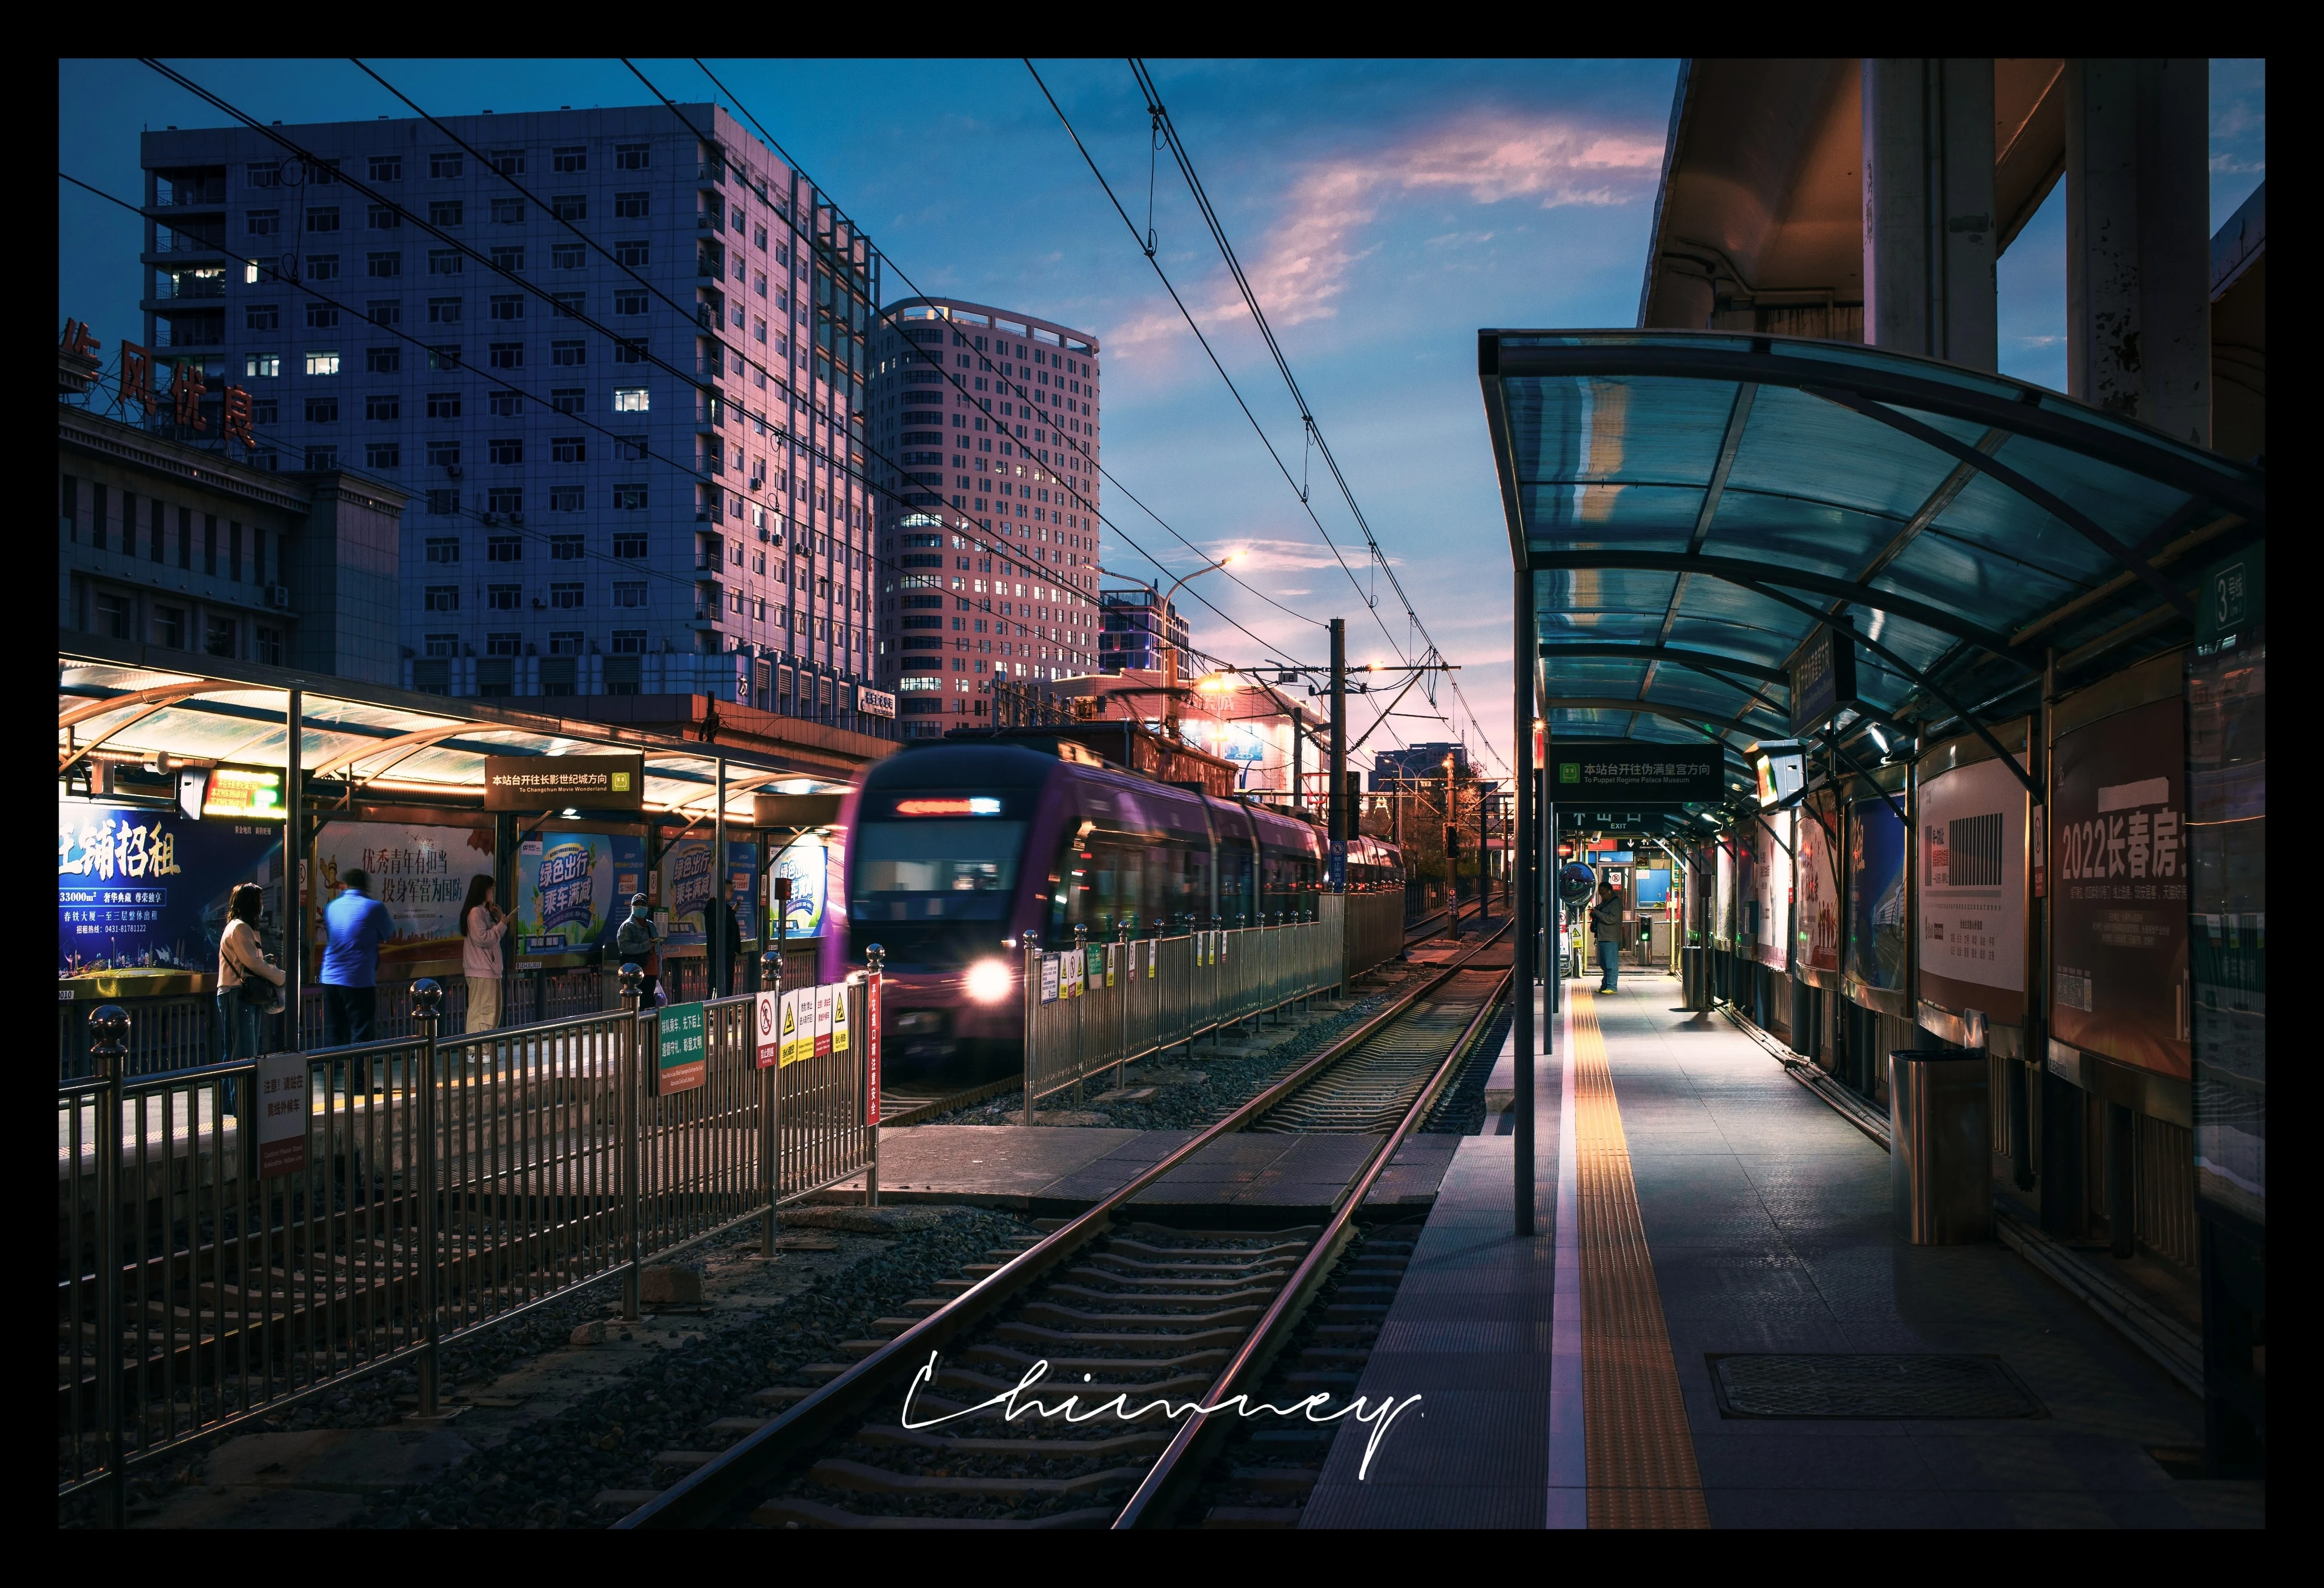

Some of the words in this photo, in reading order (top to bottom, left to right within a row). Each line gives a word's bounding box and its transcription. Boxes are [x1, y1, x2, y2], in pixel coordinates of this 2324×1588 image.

[1584, 763, 1710, 776] 本站台开往伪满皇宫方向
[492, 773, 608, 786] 本站台开往长影世纪城方向
[2062, 807, 2186, 879] 2022长春房
[362, 848, 447, 874] 优秀青年有担当
[540, 852, 588, 887] 绿色出行
[673, 852, 710, 881] 绿色出行
[104, 892, 132, 903] 奢华典藏
[135, 892, 161, 903] 尊荣独享
[382, 877, 462, 903] 投身军营为国防
[544, 880, 591, 915] 乘车满减
[676, 875, 710, 905] 乘车满减
[64, 911, 158, 922] 春铁大厦一至三层整体出租
[760, 1046, 774, 1059] 禁止跨越
[264, 1075, 304, 1094] 注意！请站在
[267, 1099, 300, 1118] 黄线外候车
[280, 1146, 292, 1155] Please
[292, 1144, 303, 1153] Stand
